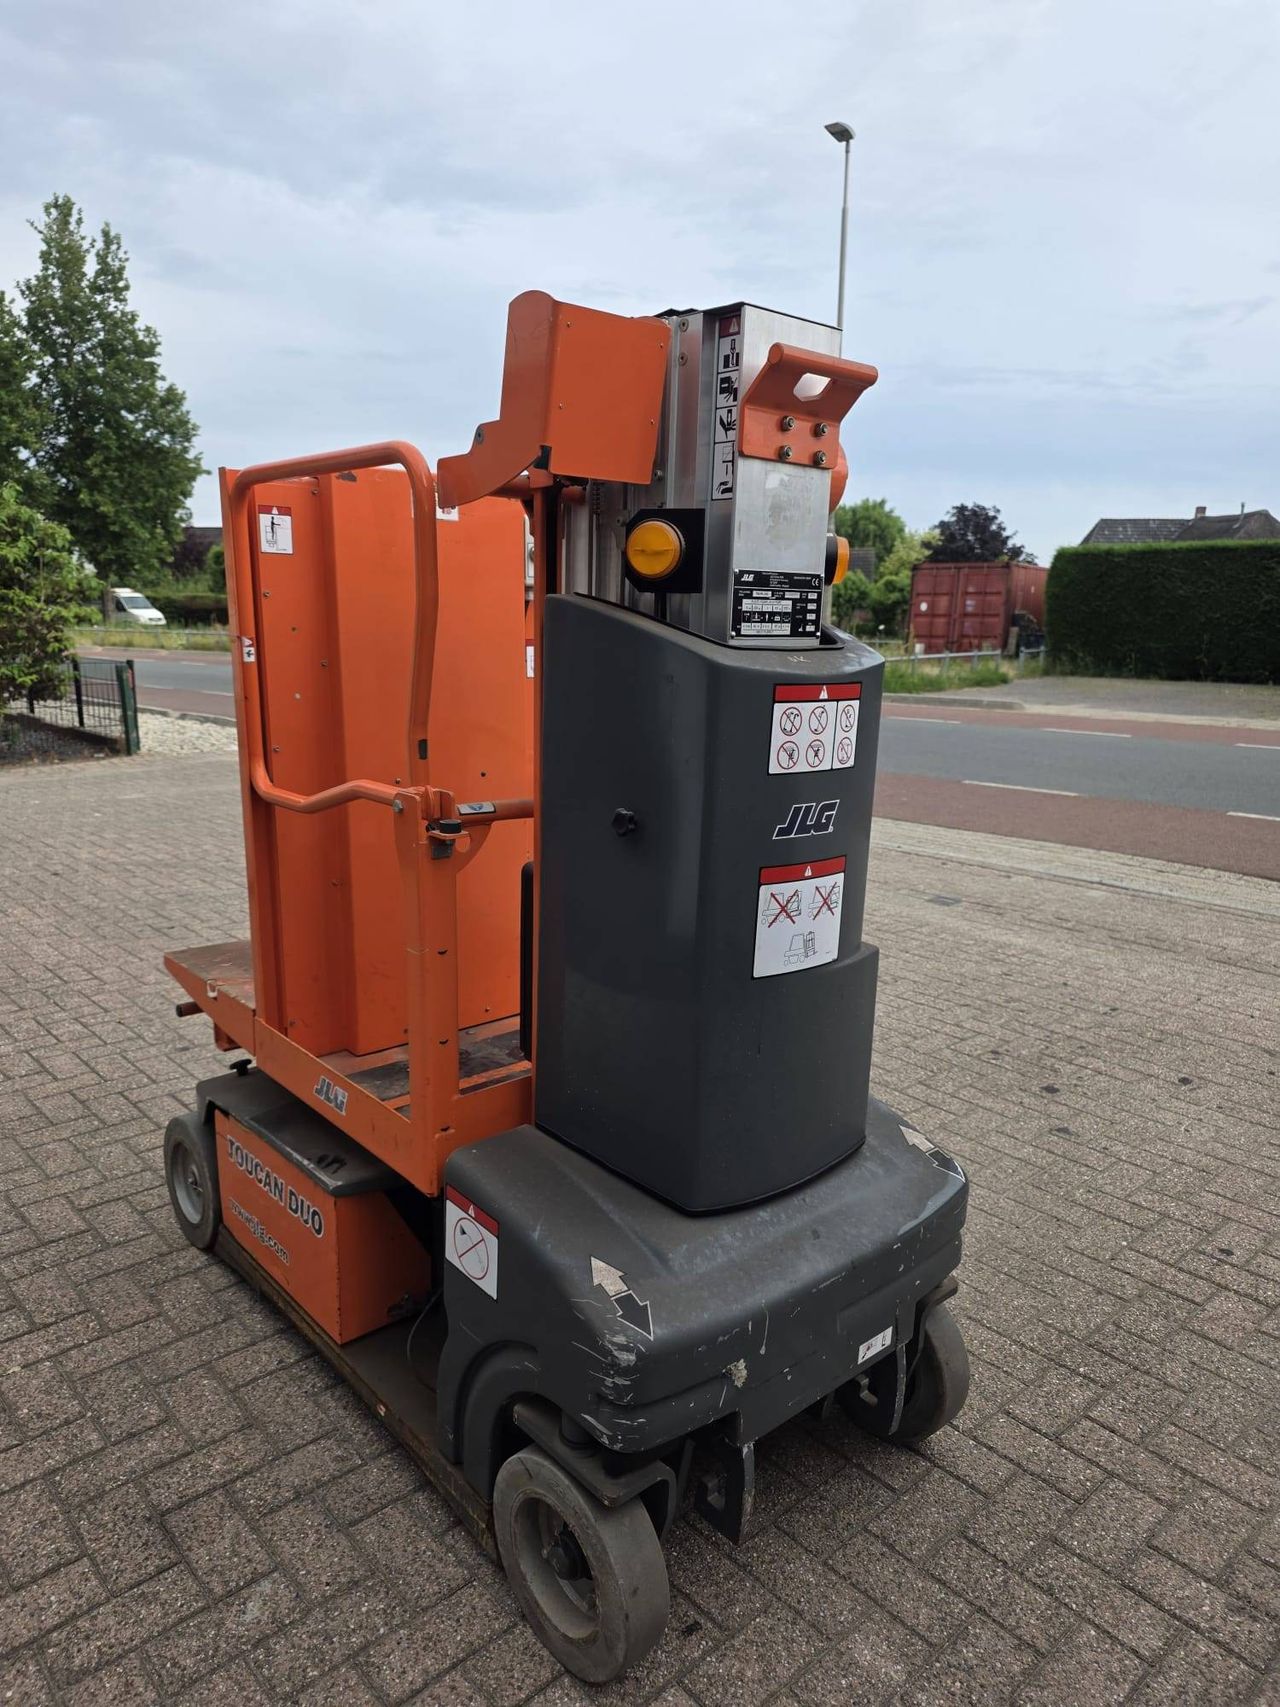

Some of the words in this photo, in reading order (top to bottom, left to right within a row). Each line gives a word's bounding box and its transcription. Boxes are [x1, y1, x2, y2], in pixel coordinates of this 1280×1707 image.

[772, 799, 840, 840] JLG
[314, 1076, 348, 1116] JLG
[227, 1135, 285, 1207] TOUCAN
[287, 1186, 325, 1239] DUO
